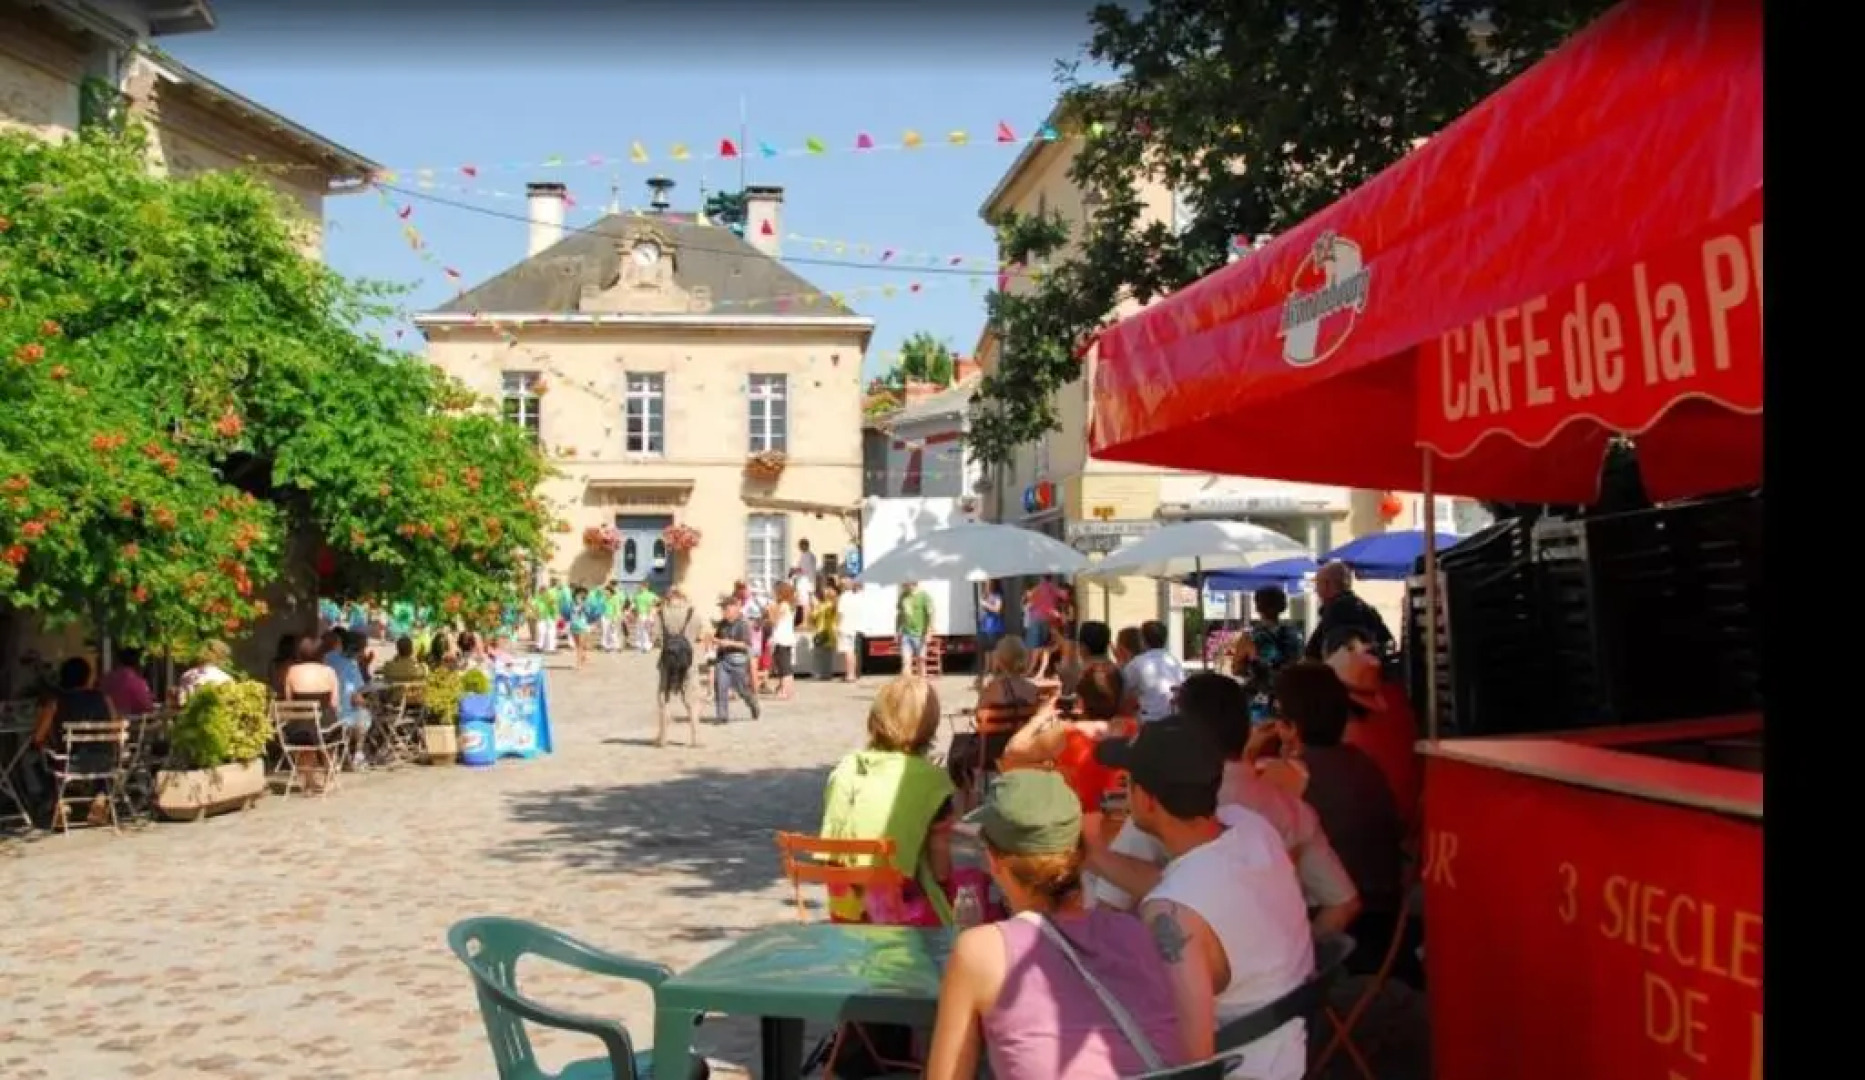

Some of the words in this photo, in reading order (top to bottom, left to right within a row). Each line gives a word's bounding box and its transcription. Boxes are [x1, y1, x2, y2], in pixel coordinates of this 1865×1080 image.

[1441, 295, 1554, 422] CAFE
[1562, 282, 1624, 399] de
[1633, 262, 1696, 386] la
[1558, 861, 1578, 924] 3
[1644, 968, 1709, 1063] DE
